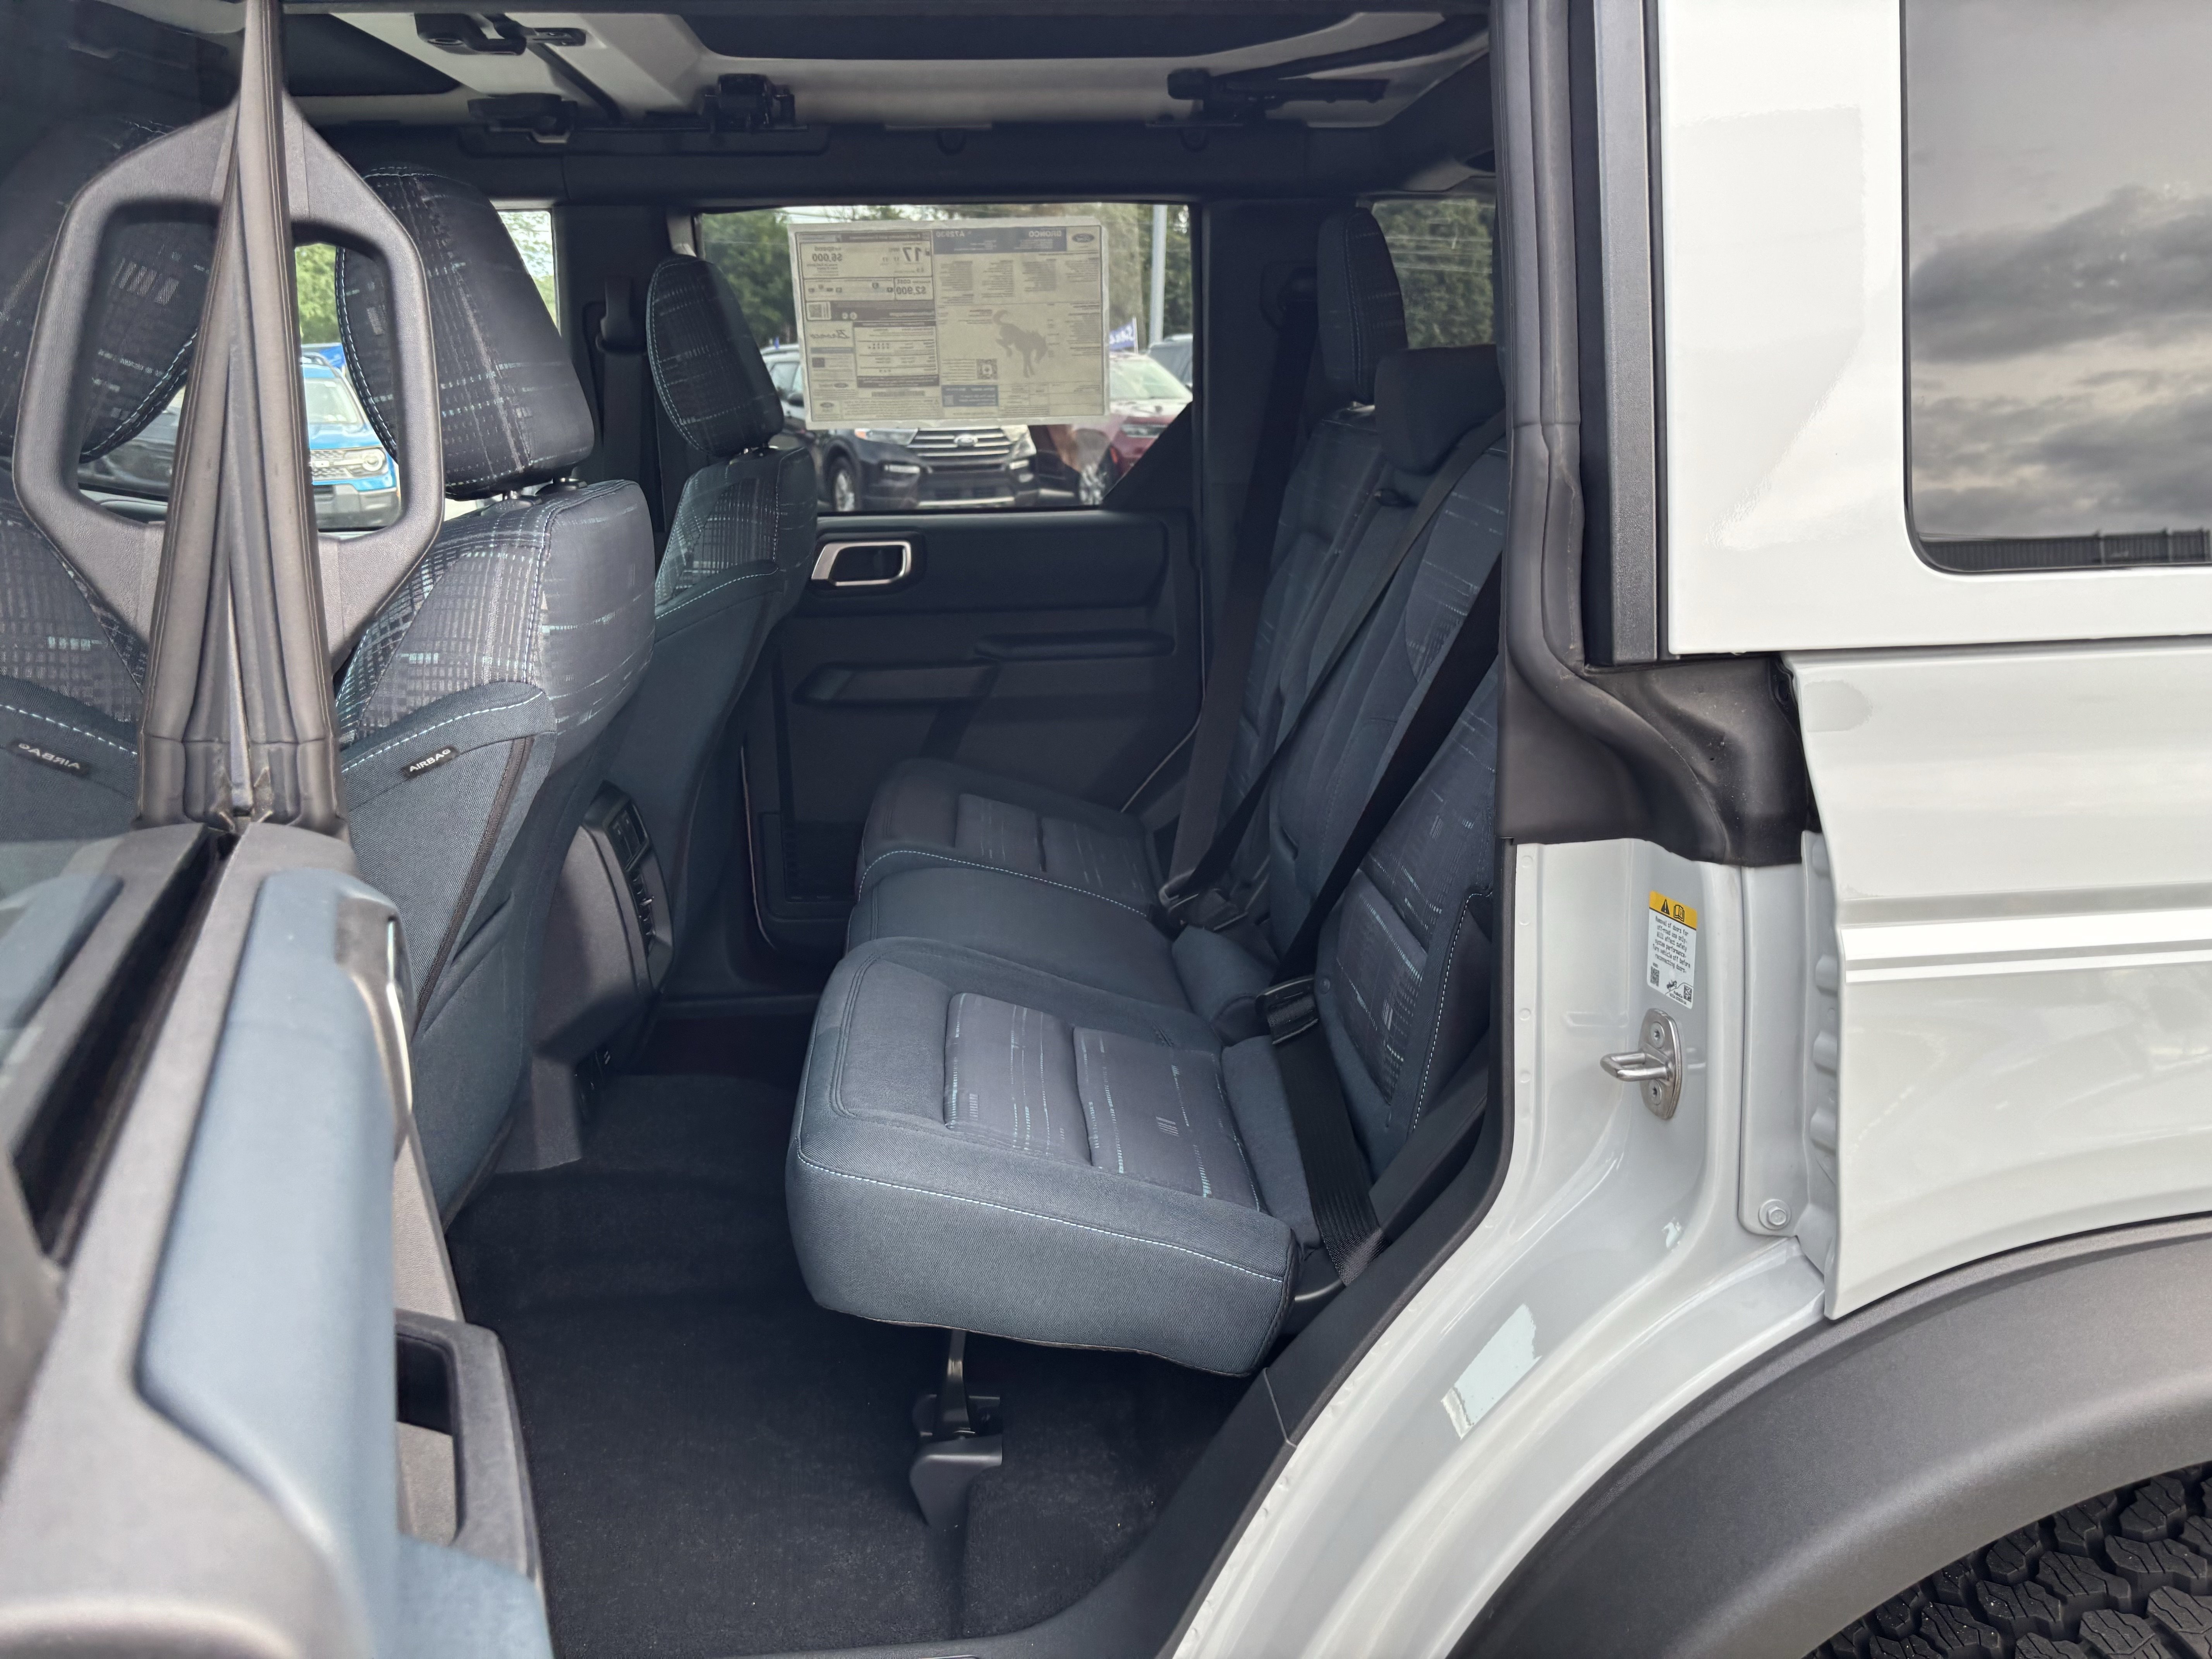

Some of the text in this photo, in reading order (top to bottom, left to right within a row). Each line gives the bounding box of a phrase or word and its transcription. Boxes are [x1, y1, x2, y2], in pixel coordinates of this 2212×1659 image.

[410, 749, 451, 772] AIRBAG
[1673, 925, 1681, 933] doors
[1676, 942, 1686, 952] safety
[1661, 949, 1672, 959] vehicle
[1680, 958, 1690, 969] before
